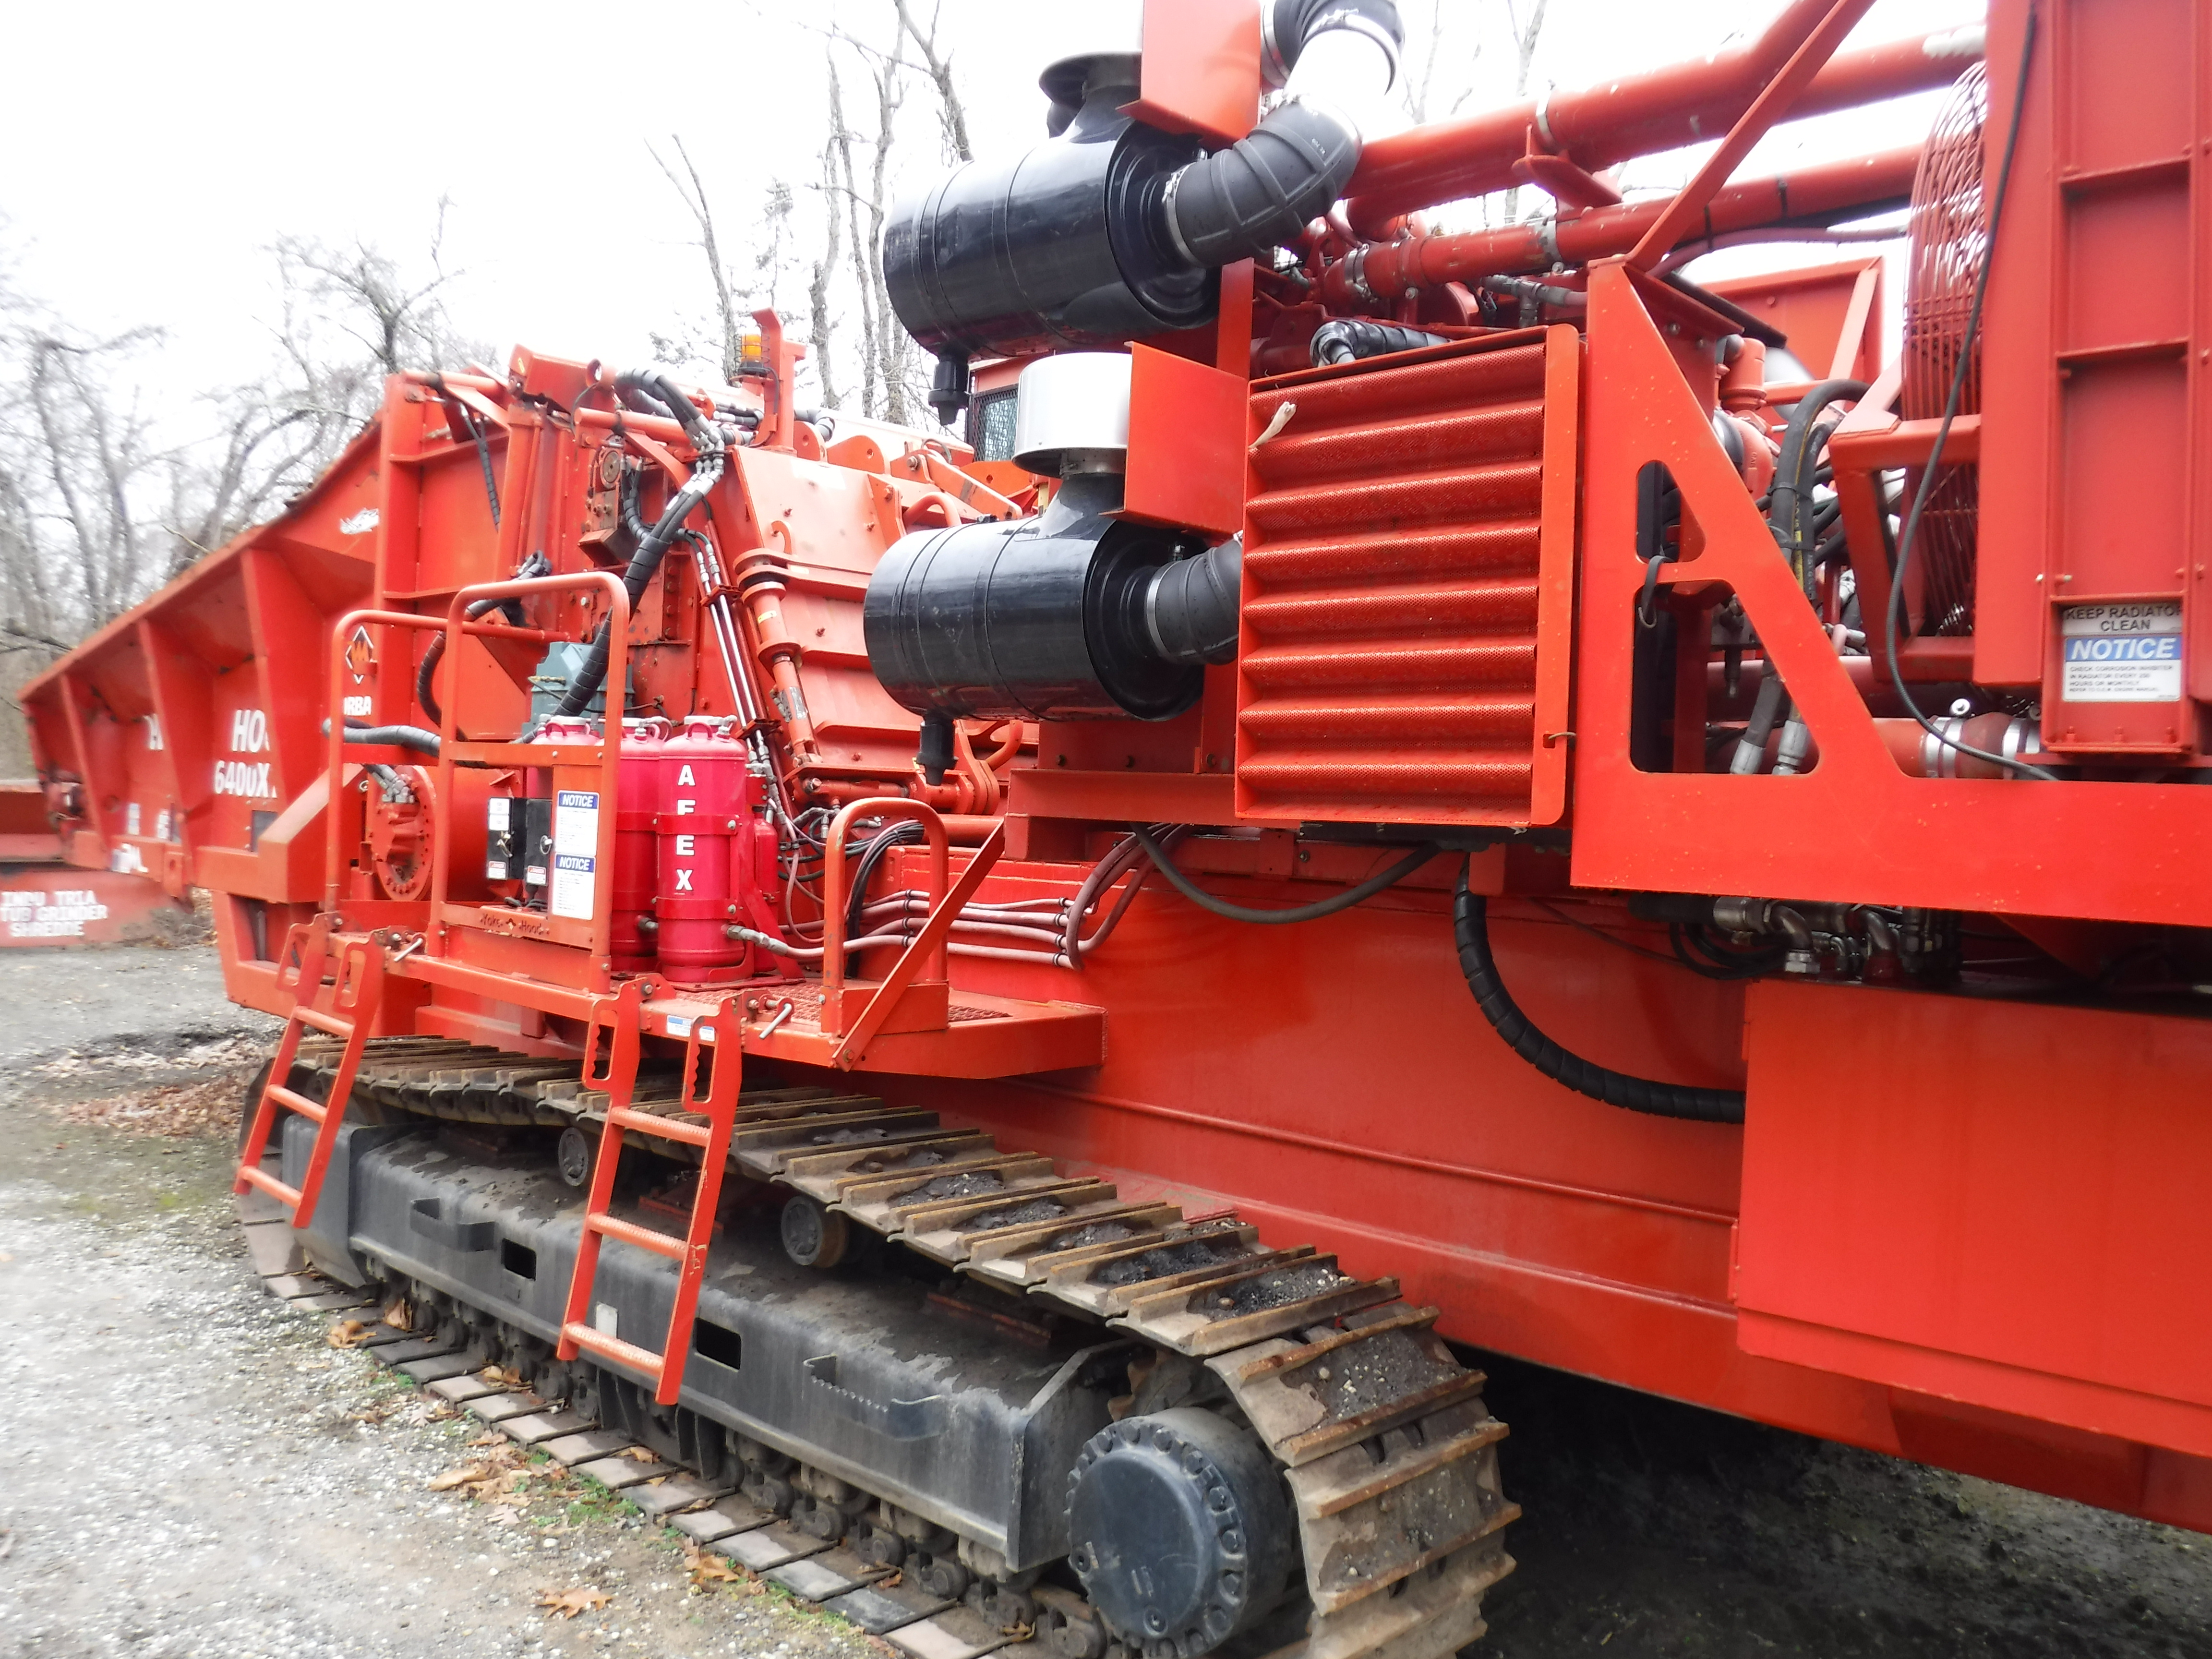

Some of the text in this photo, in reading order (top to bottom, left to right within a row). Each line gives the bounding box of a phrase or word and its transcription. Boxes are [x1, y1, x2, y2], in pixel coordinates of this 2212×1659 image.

[2067, 608, 2104, 620] KEEP
[2101, 620, 2151, 631] CLEAN
[2071, 637, 2176, 660] NOTICE
[232, 709, 270, 753] HO
[215, 760, 277, 799] 6400X
[562, 794, 594, 807] NOTICE
[675, 764, 696, 890] AFEX
[559, 856, 590, 870] NOTICE
[36, 904, 108, 921] GRINDER
